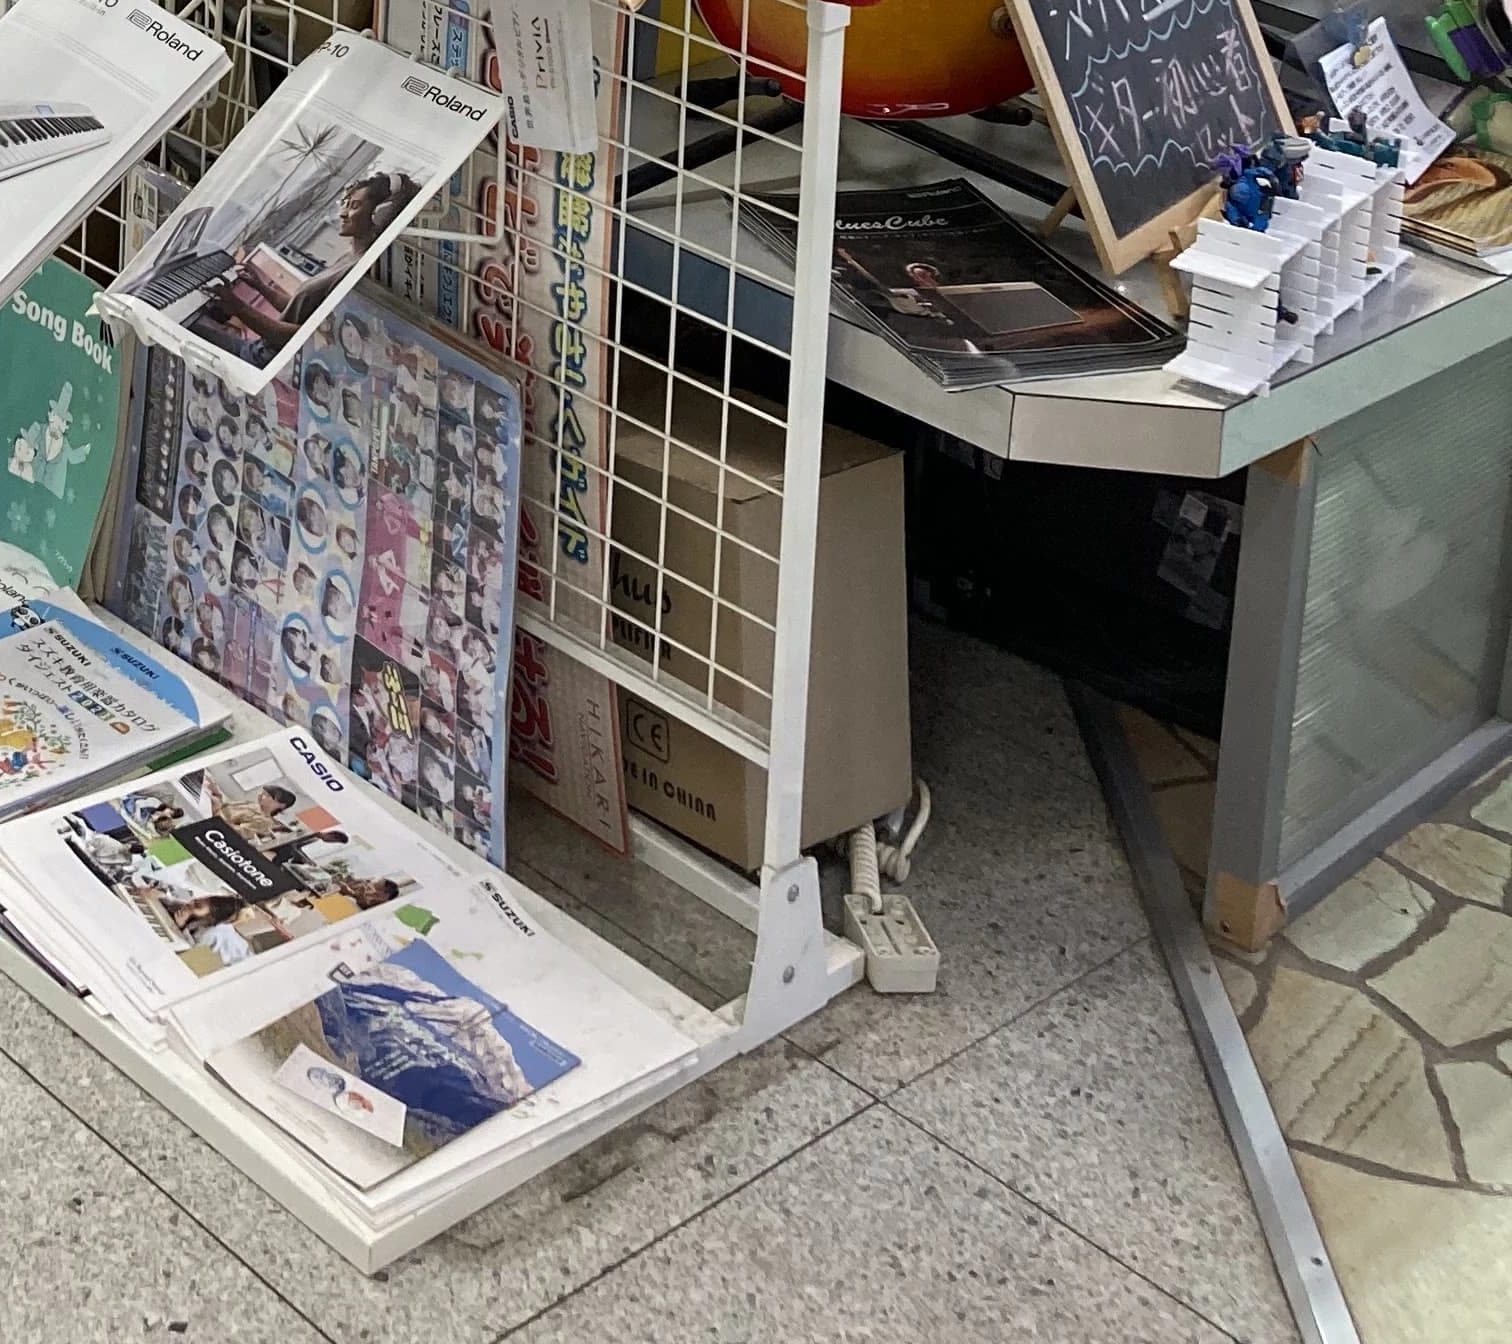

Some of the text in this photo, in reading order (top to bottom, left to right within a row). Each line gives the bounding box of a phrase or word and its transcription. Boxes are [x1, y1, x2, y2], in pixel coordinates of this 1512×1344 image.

[147, 19, 203, 62] Roland
[423, 85, 488, 122] Roland
[506, 95, 520, 140] CASIO
[11, 289, 114, 375] Song Book
[54, 633, 92, 667] SUZUKI
[123, 650, 161, 682] SUZUKI
[289, 735, 345, 793] CASIO
[586, 698, 612, 830] HIKARI
[662, 779, 717, 823] CHINA
[204, 828, 273, 889] Casiotone
[490, 890, 536, 939] SUZUKI
